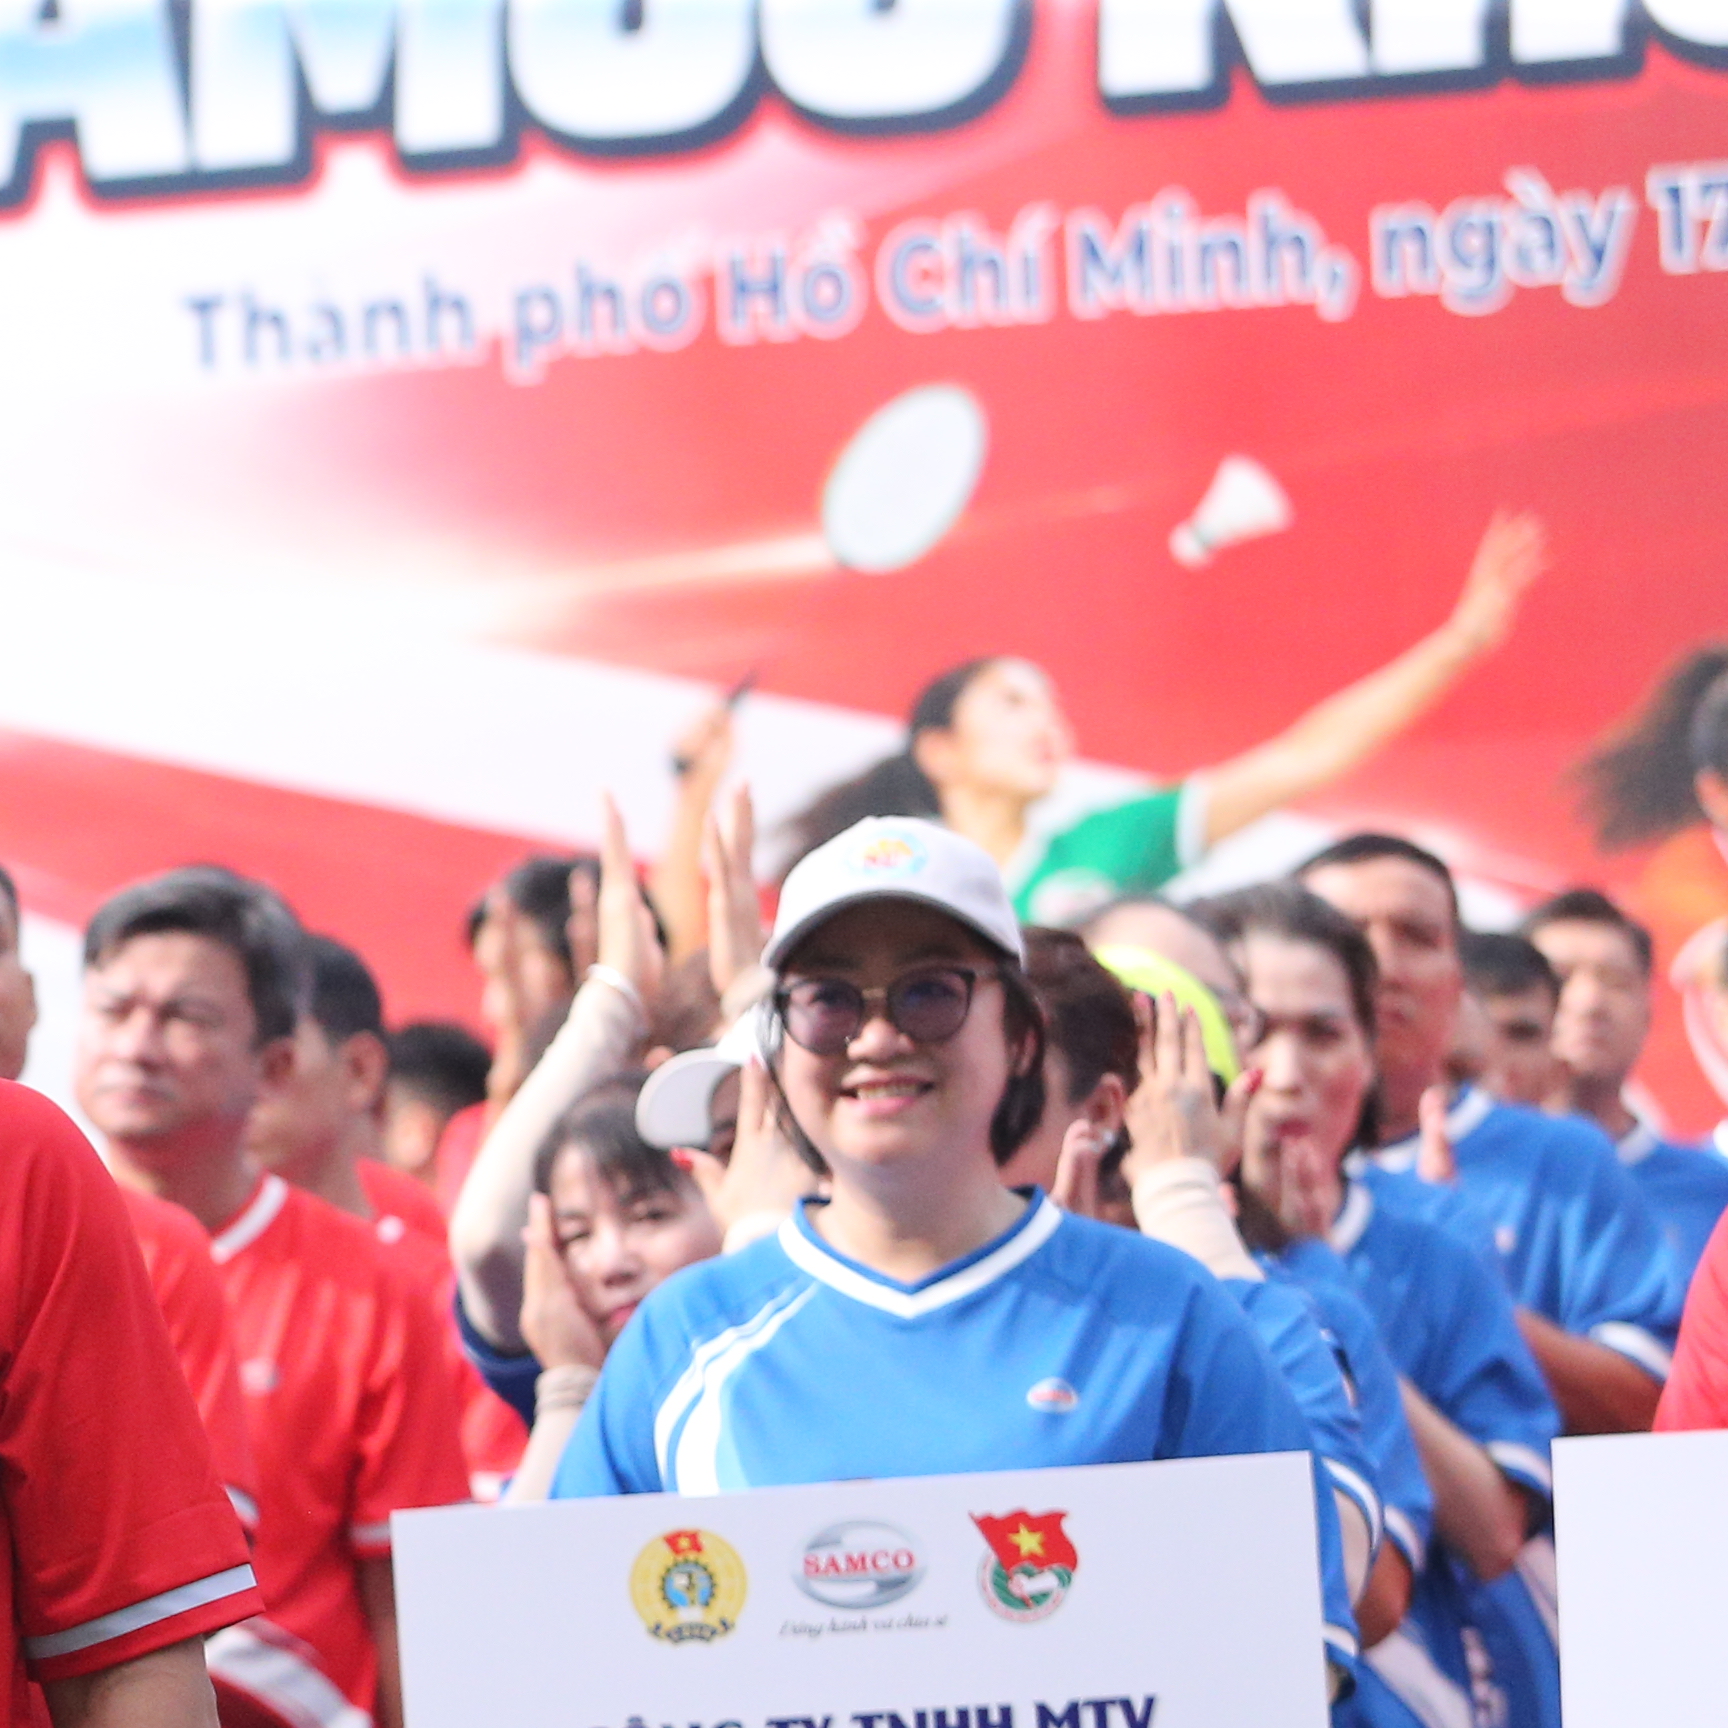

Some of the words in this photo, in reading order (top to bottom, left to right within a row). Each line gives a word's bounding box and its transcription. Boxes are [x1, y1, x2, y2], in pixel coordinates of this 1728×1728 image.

[891, 205, 1048, 317] Chí
[1078, 200, 1348, 314] Minh,
[1382, 172, 1624, 298] ngày
[803, 1548, 916, 1578] SAMCO
